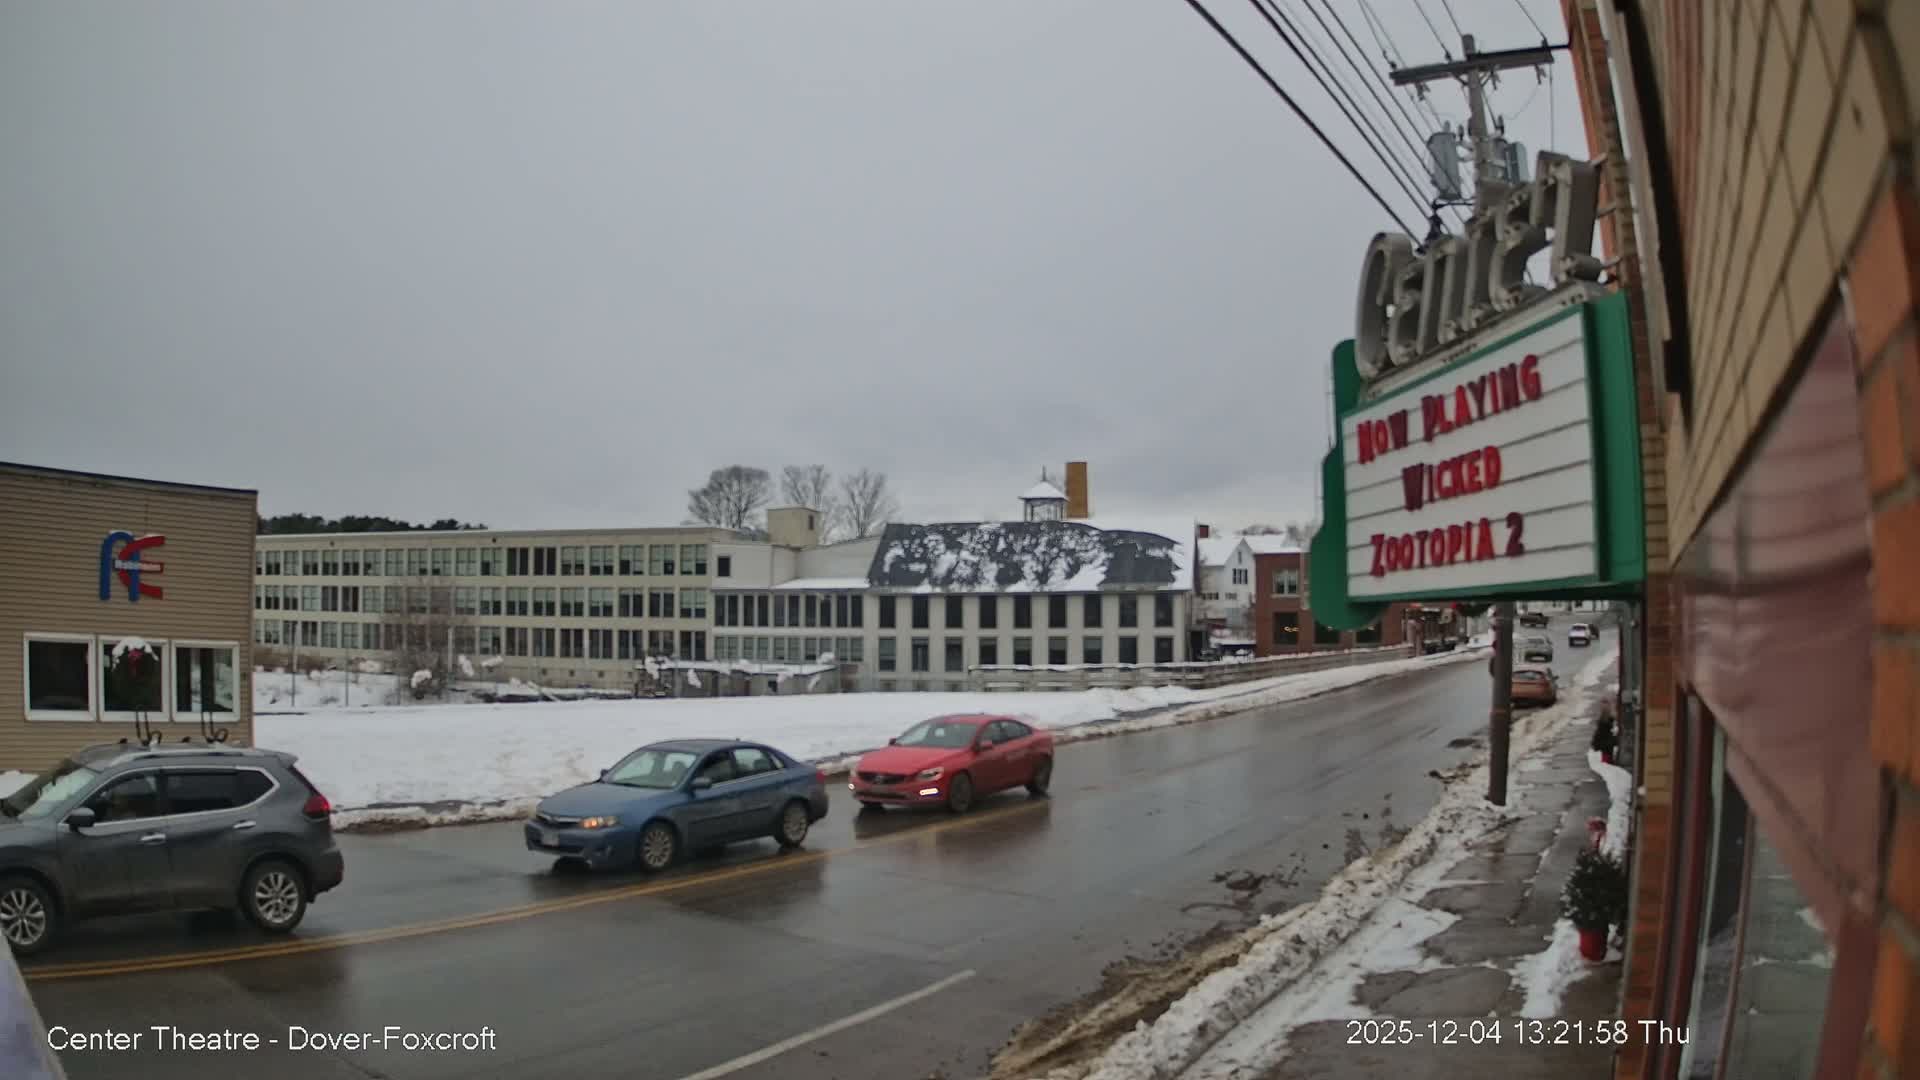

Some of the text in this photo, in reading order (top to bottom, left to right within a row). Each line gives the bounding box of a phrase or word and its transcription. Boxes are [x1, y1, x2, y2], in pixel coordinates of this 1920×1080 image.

[1357, 354, 1542, 465] NOW PLAYING
[1402, 446, 1502, 511] WICKED
[1370, 512, 1525, 577] ZOOTOPIA 2
